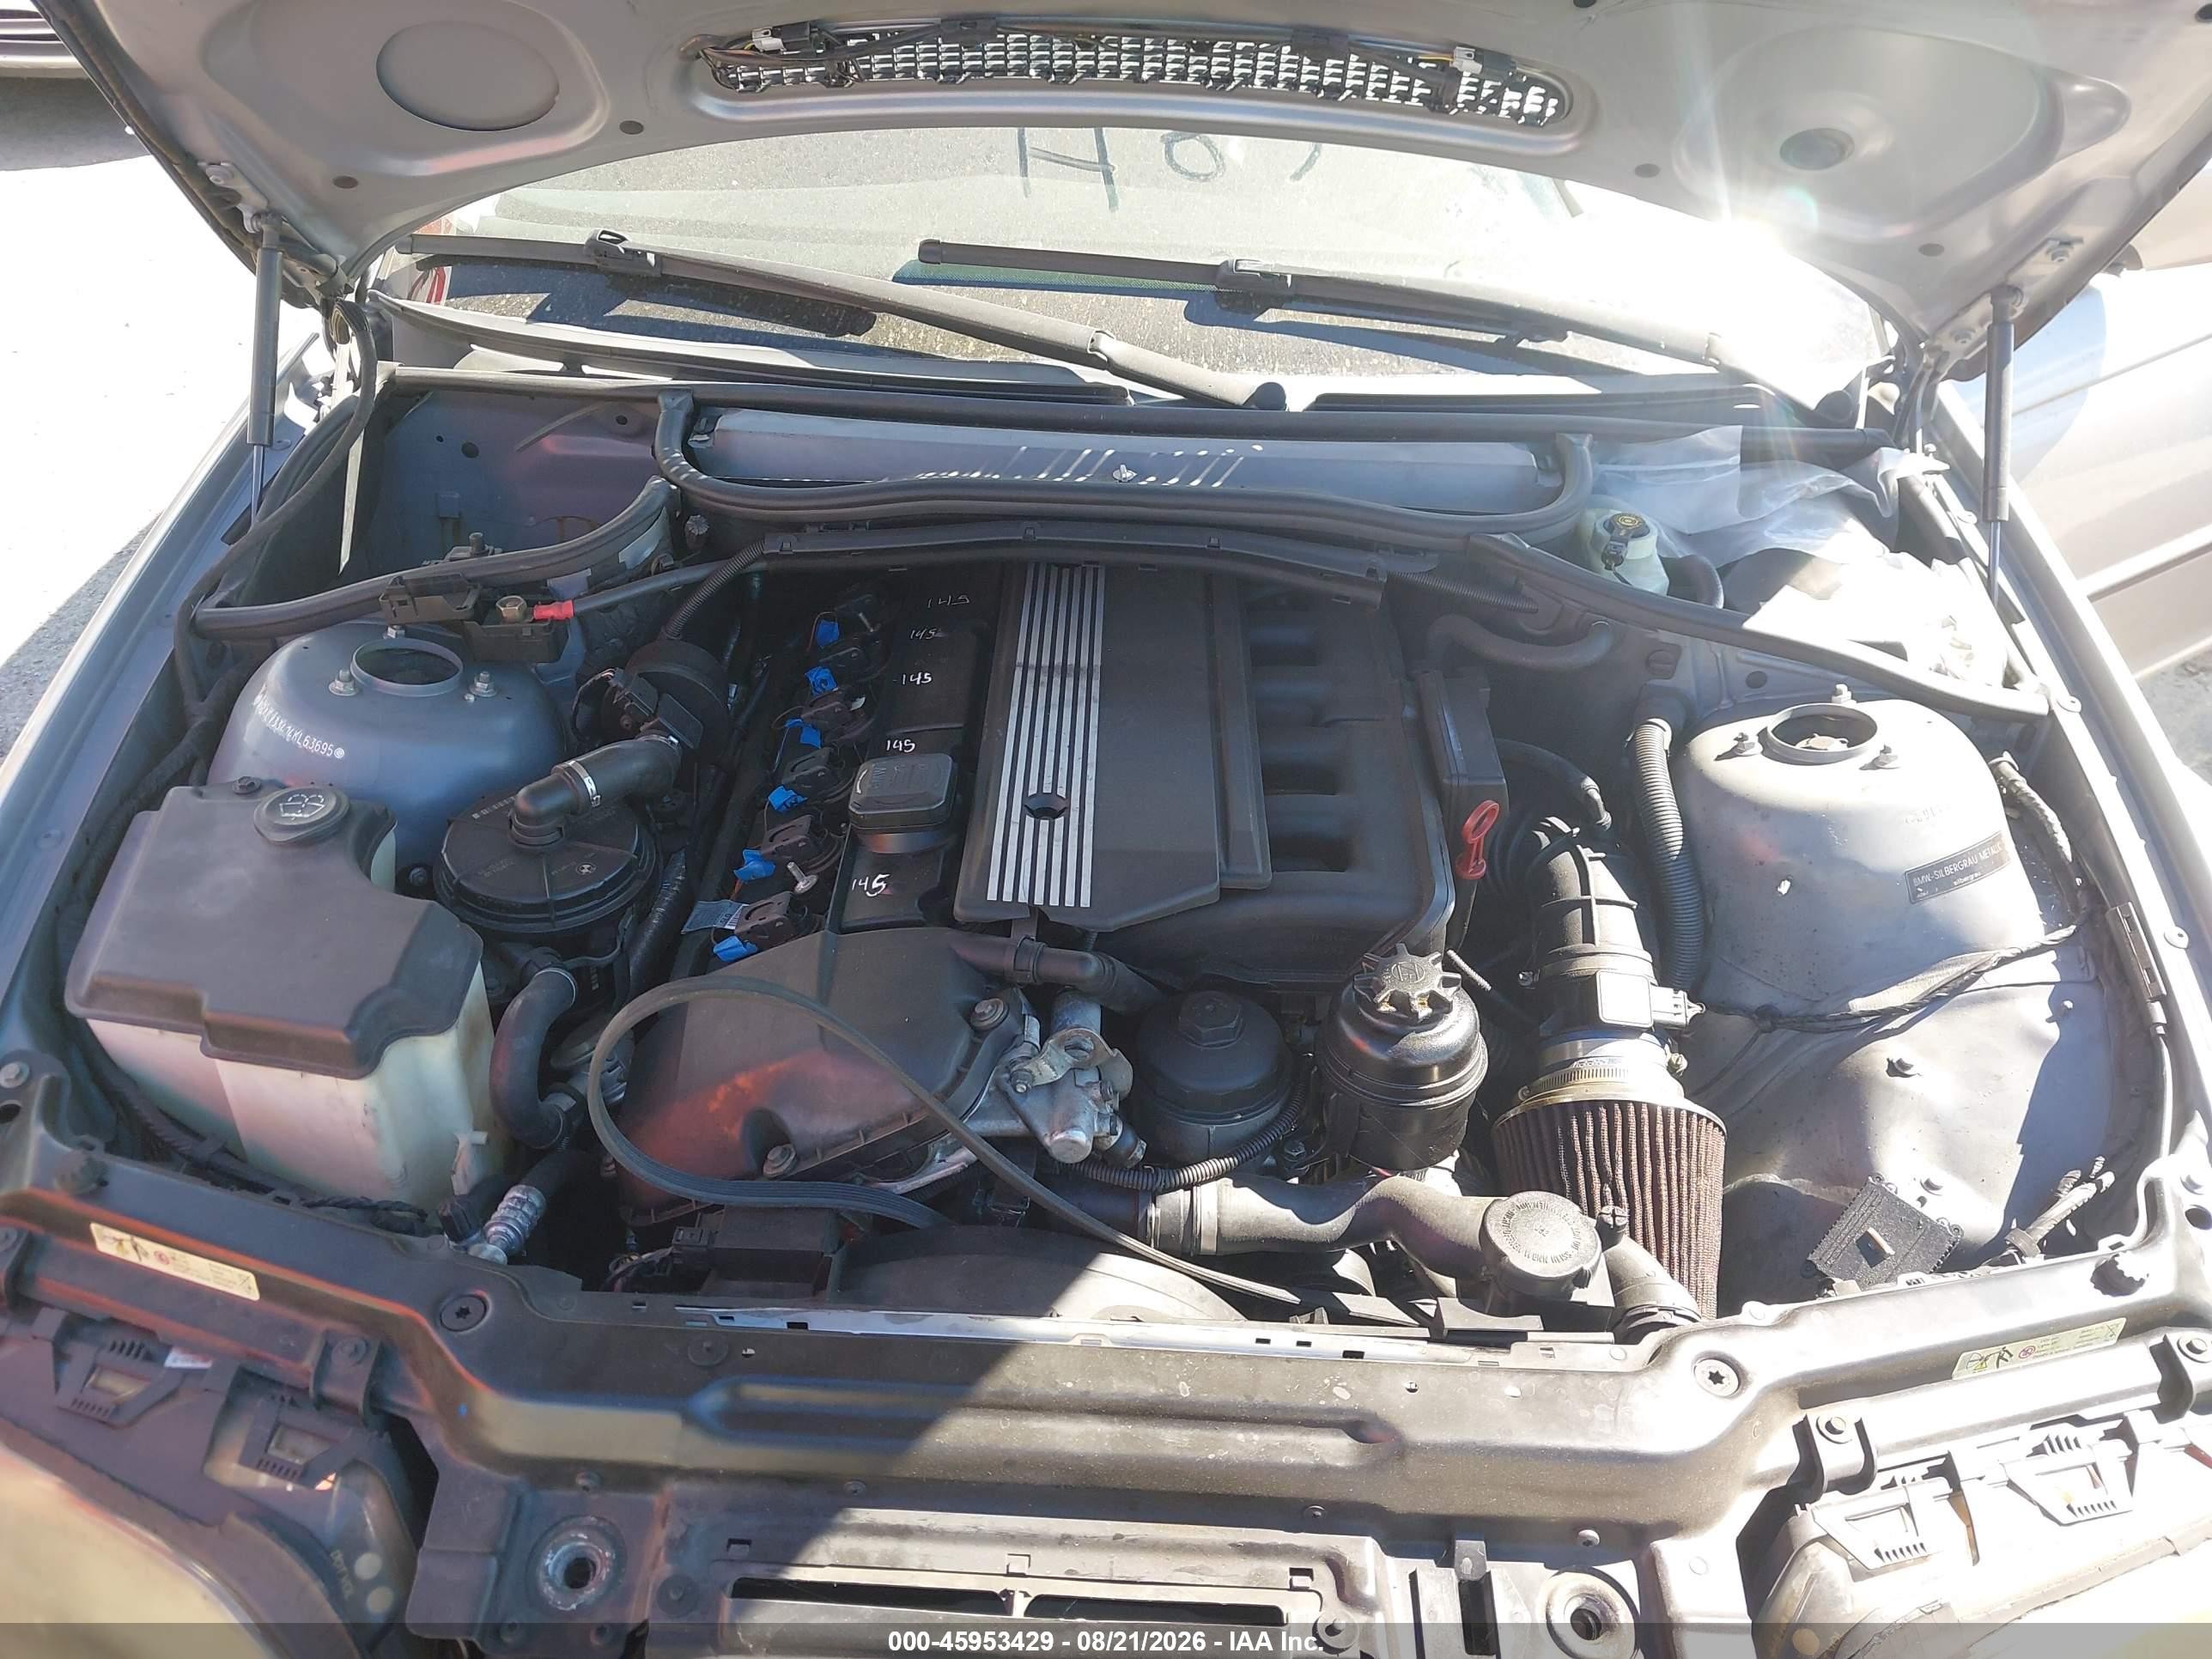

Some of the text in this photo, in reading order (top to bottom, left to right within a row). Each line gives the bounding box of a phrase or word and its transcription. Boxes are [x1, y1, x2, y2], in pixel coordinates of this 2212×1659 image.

[902, 672, 933, 685] 145
[886, 738, 916, 753] 145
[1912, 855, 1978, 887] BMW-SILBERGRAU
[851, 873, 891, 897] 145
